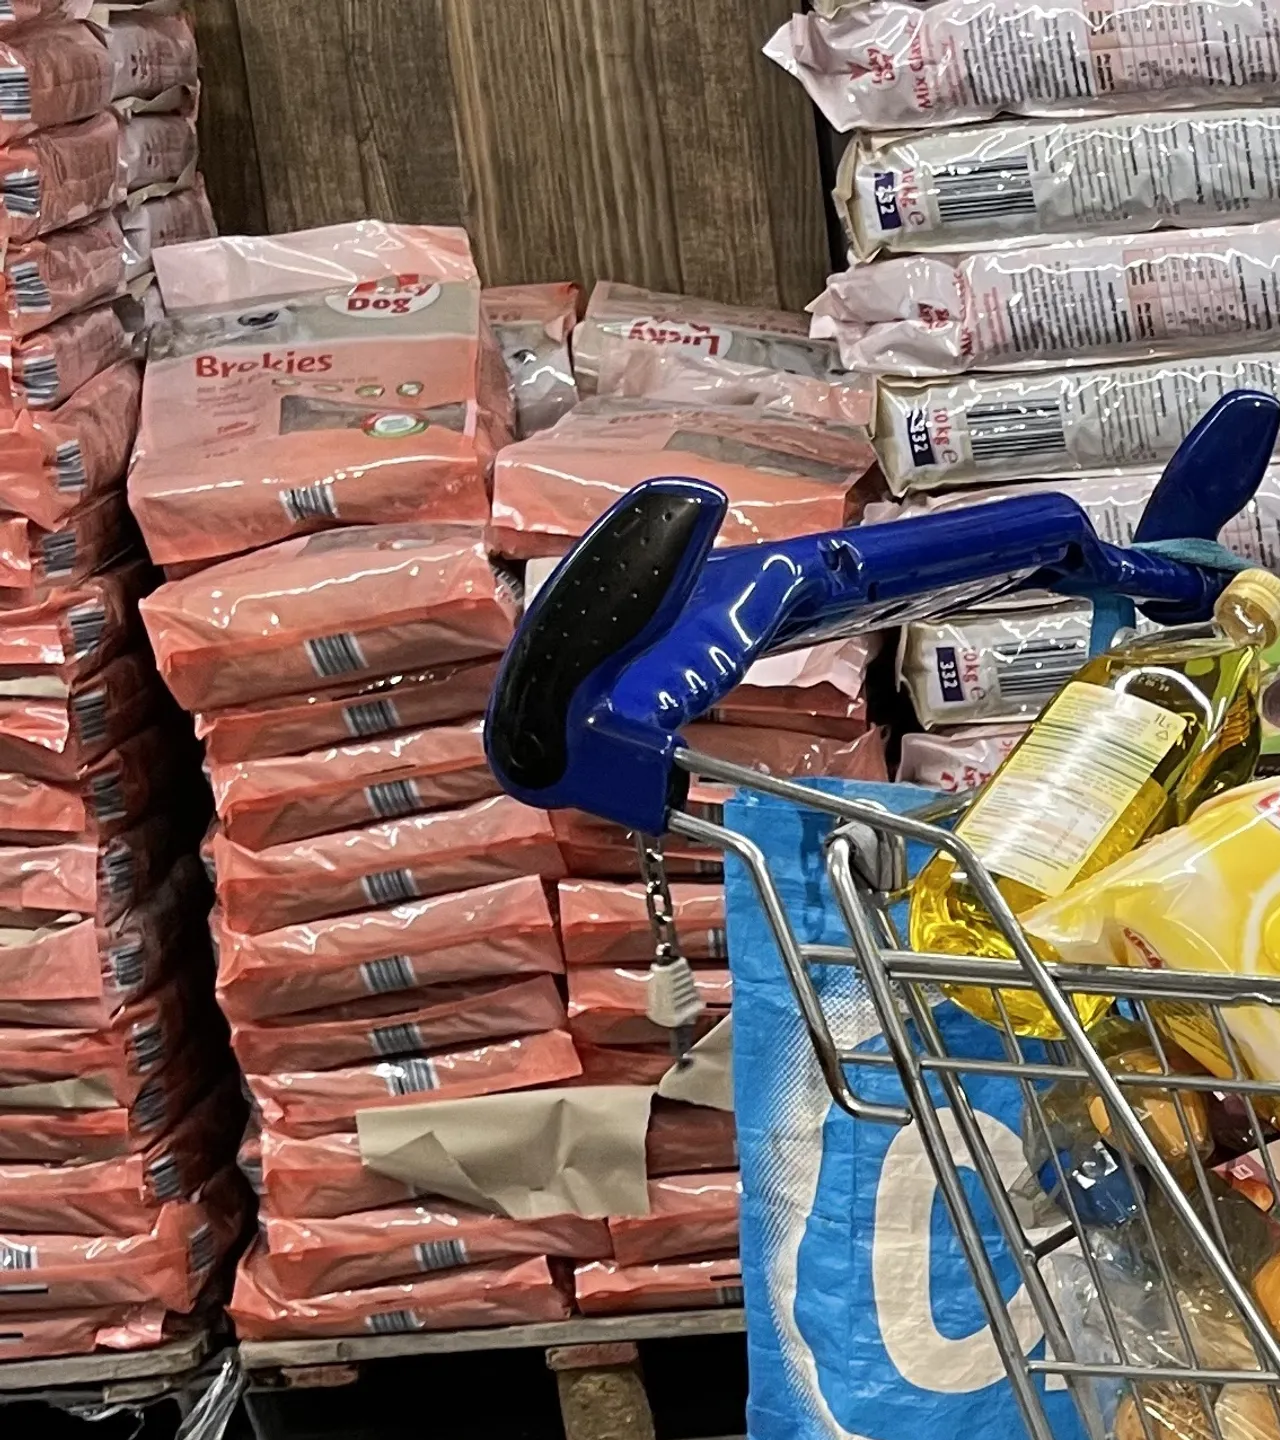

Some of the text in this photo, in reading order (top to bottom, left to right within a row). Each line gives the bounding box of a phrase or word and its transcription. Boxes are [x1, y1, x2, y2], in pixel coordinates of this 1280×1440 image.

[347, 296, 413, 314] Dog
[195, 350, 334, 379] Brokjes
[940, 660, 957, 689] 332
